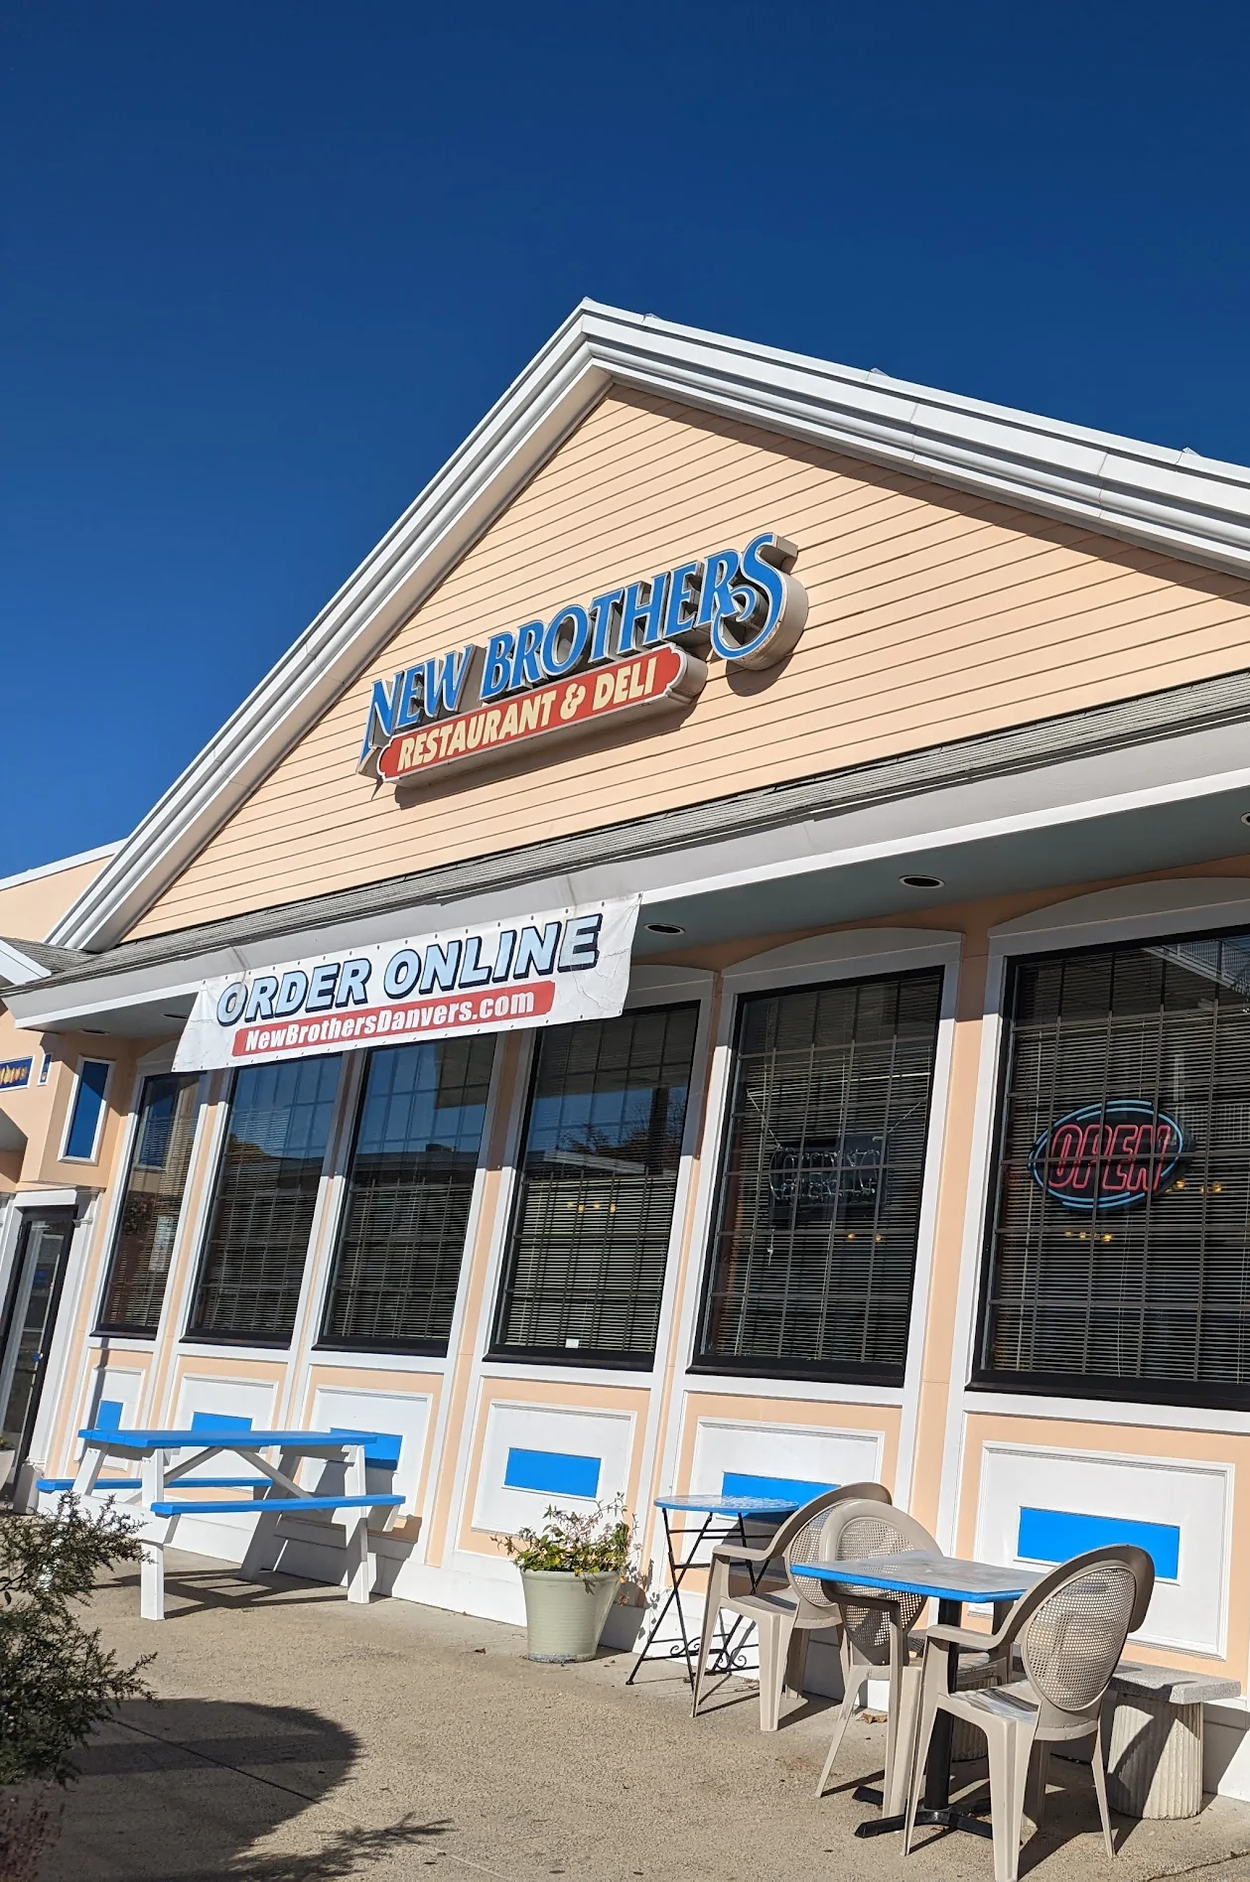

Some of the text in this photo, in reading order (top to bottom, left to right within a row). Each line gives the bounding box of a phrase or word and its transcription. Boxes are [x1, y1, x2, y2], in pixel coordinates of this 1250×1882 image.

[359, 532, 787, 766] NEW BROTHERS
[397, 657, 657, 772] RESTAURANT & DELI
[216, 913, 603, 1026] ORDER ONLINE
[245, 989, 536, 1052] NewBrothersDanvers.com
[1048, 1123, 1171, 1191] OPEN
